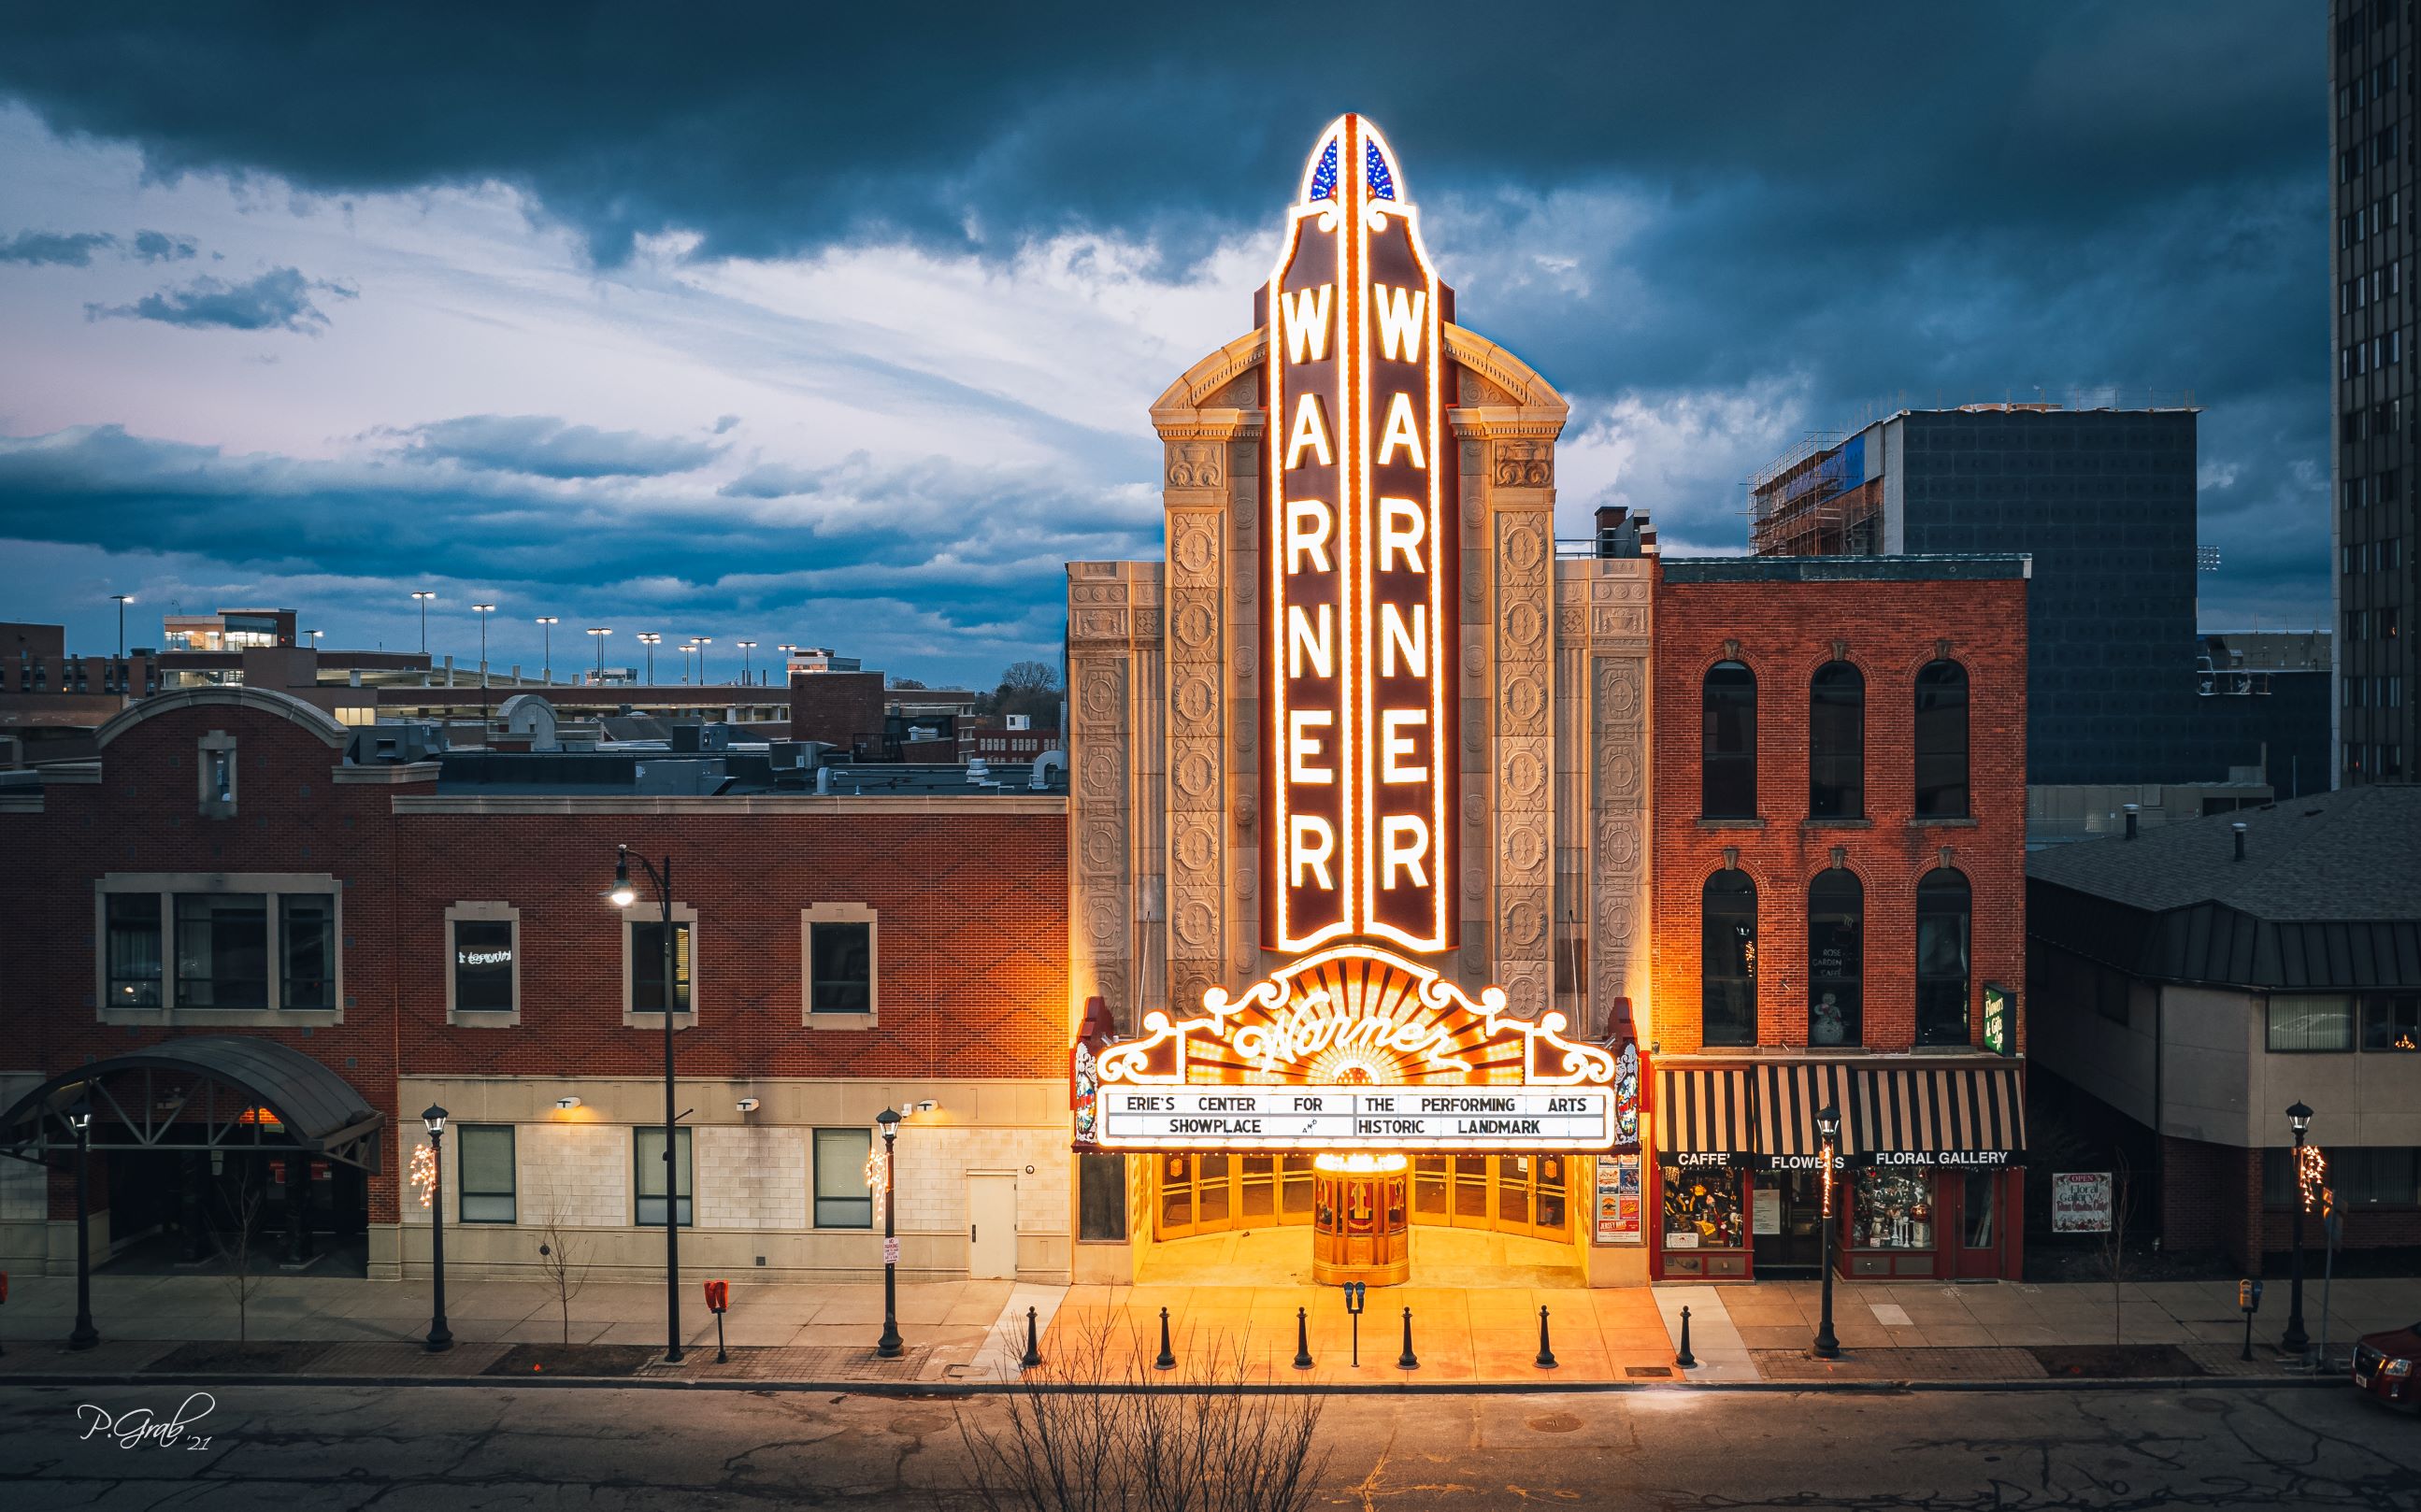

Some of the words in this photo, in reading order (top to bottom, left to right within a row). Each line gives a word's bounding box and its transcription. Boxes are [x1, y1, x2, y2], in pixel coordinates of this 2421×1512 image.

[1281, 283, 1335, 890] WARNER
[1374, 283, 1430, 890] WARNER
[1823, 949, 1841, 957] ROSE
[1233, 991, 1472, 1074] Warner
[1128, 1097, 1174, 1110] ERIE'S
[1199, 1098, 1255, 1110] CENTER
[1295, 1098, 1322, 1110] FOR
[1366, 1098, 1394, 1111] THE
[1423, 1098, 1514, 1111] PERFORMING
[1549, 1098, 1586, 1111] ARTS
[1170, 1120, 1261, 1133] SHOWPLACE
[1302, 1119, 1317, 1134] AND
[1359, 1120, 1424, 1134] HISTORIC
[1459, 1120, 1540, 1134] LANDMARK
[1876, 1152, 1934, 1164] FLORAL
[1939, 1151, 2008, 1164] GALLERY
